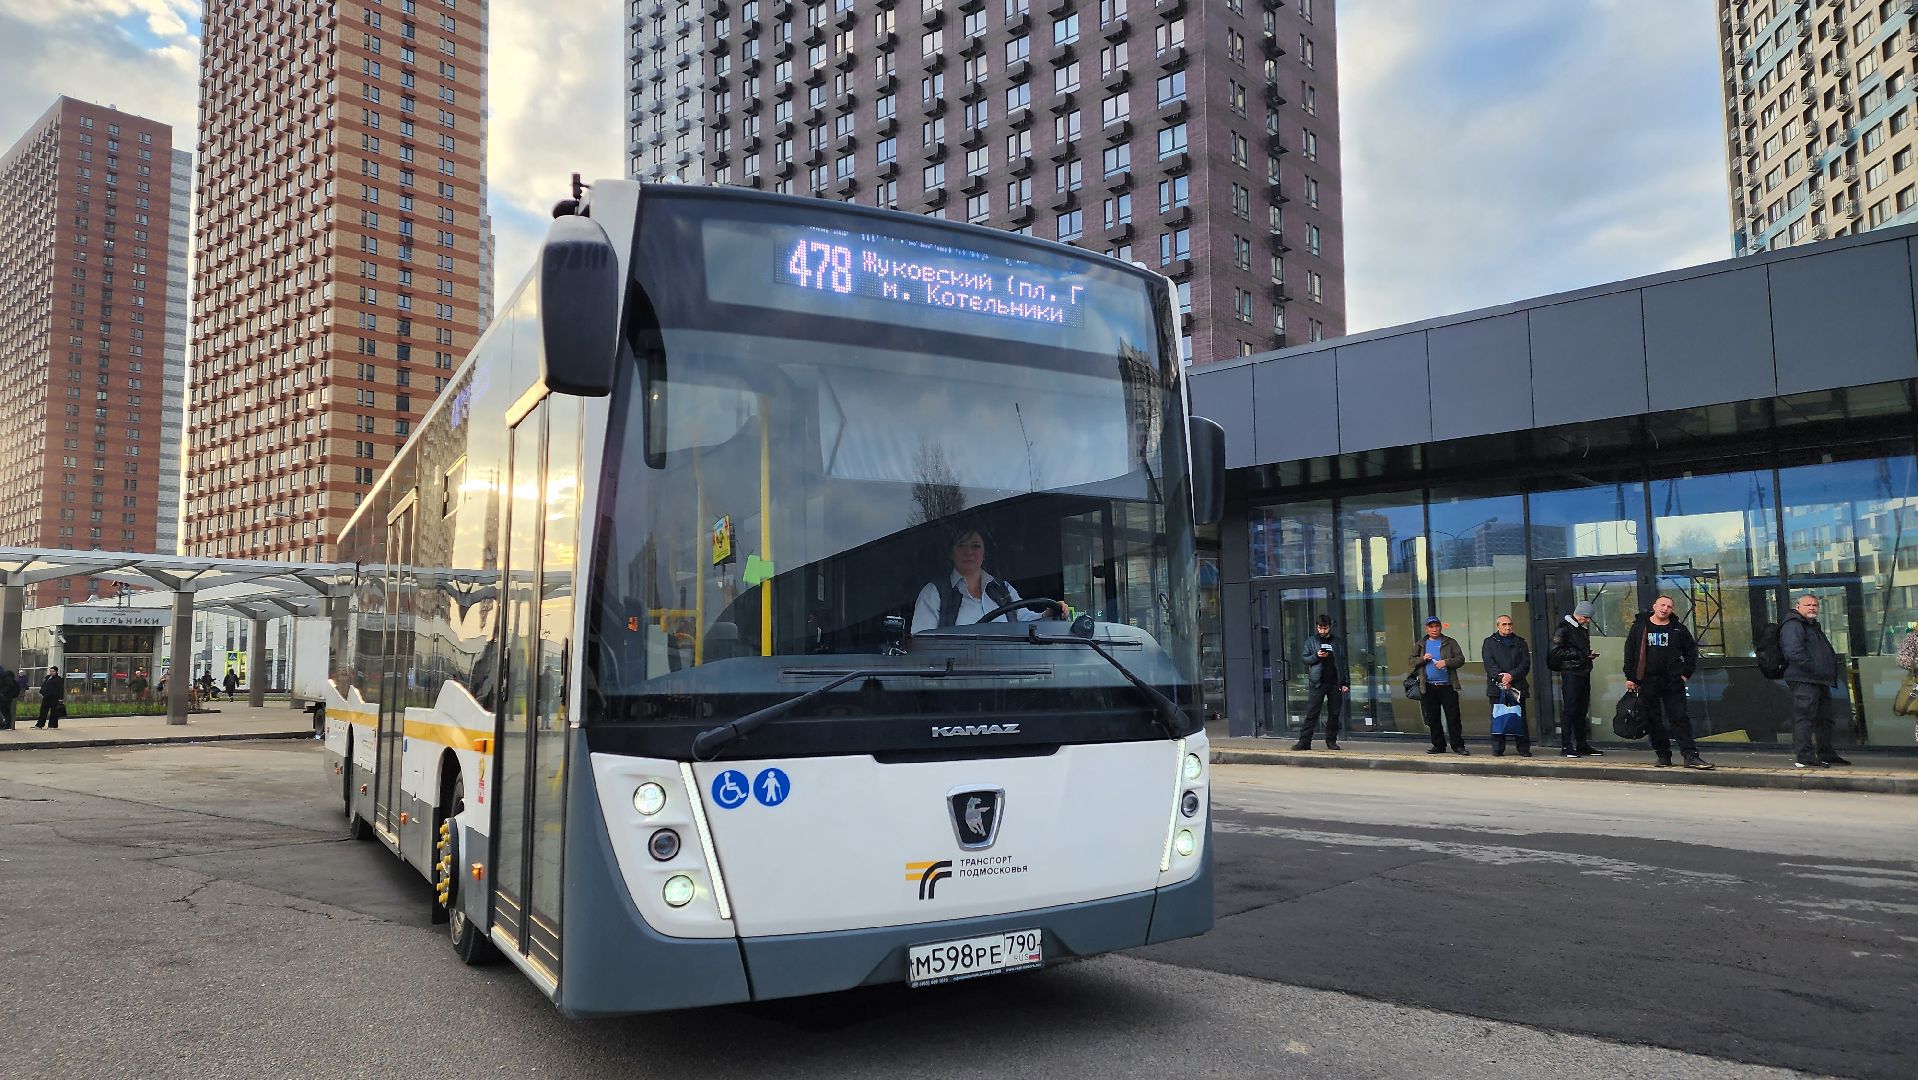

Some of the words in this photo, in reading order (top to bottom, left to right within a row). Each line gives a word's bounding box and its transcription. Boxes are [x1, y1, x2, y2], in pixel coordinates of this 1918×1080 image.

[789, 239, 852, 294] 478
[862, 250, 992, 291] Жуковский
[927, 283, 1064, 323] Котельники
[77, 616, 160, 625] КОТЕЛЬНИКИ
[931, 723, 1021, 738] KAMAZ
[960, 855, 1013, 868] ТРАНСПОРТ
[959, 865, 1028, 878] ПОДМОСКОВЬЯ
[1005, 933, 1036, 955] 790
[1014, 954, 1029, 962] RUS
